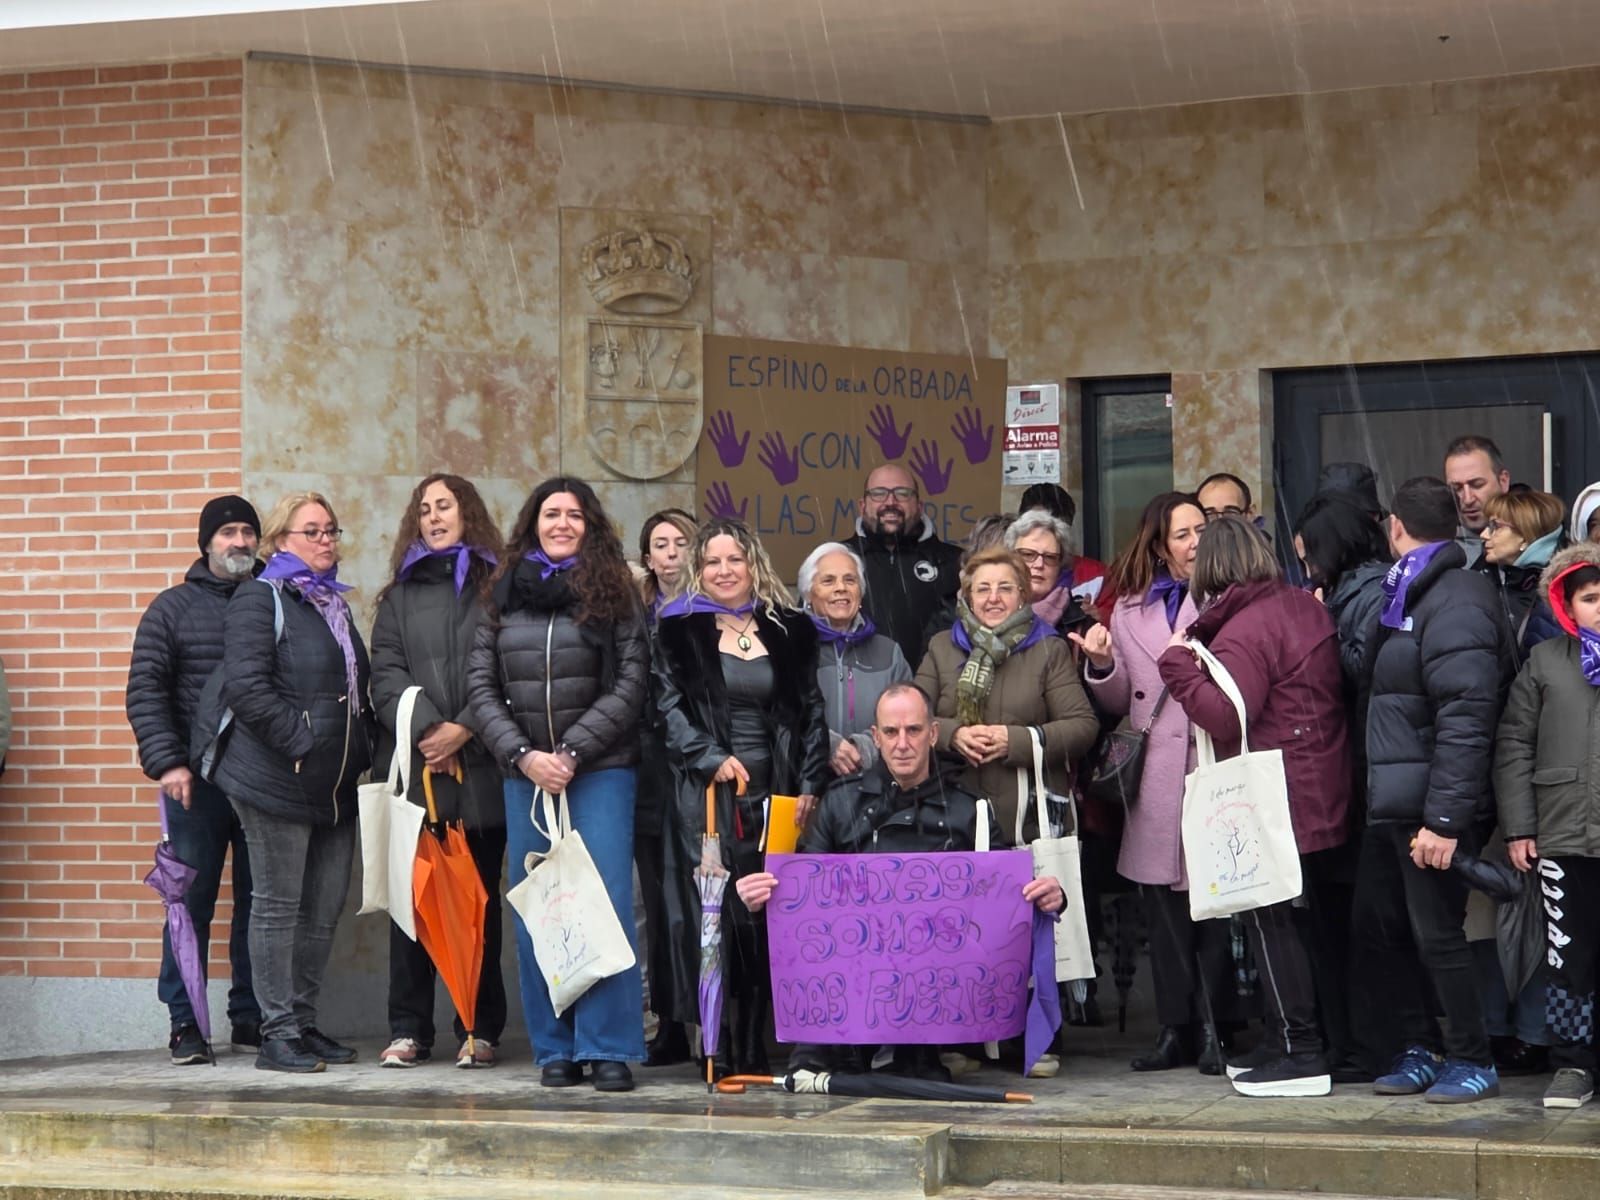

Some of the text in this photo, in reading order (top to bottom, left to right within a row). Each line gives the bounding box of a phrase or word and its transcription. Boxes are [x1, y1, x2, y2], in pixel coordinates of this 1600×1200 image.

[728, 354, 974, 401] ESPINO DE LA ORBADA
[800, 431, 861, 470] CON
[1006, 428, 1058, 443] Alarma
[756, 495, 816, 536] LAS
[777, 856, 974, 914] JUNTAS
[796, 906, 968, 963] SOMOS
[865, 959, 1028, 1029] FUERTES
